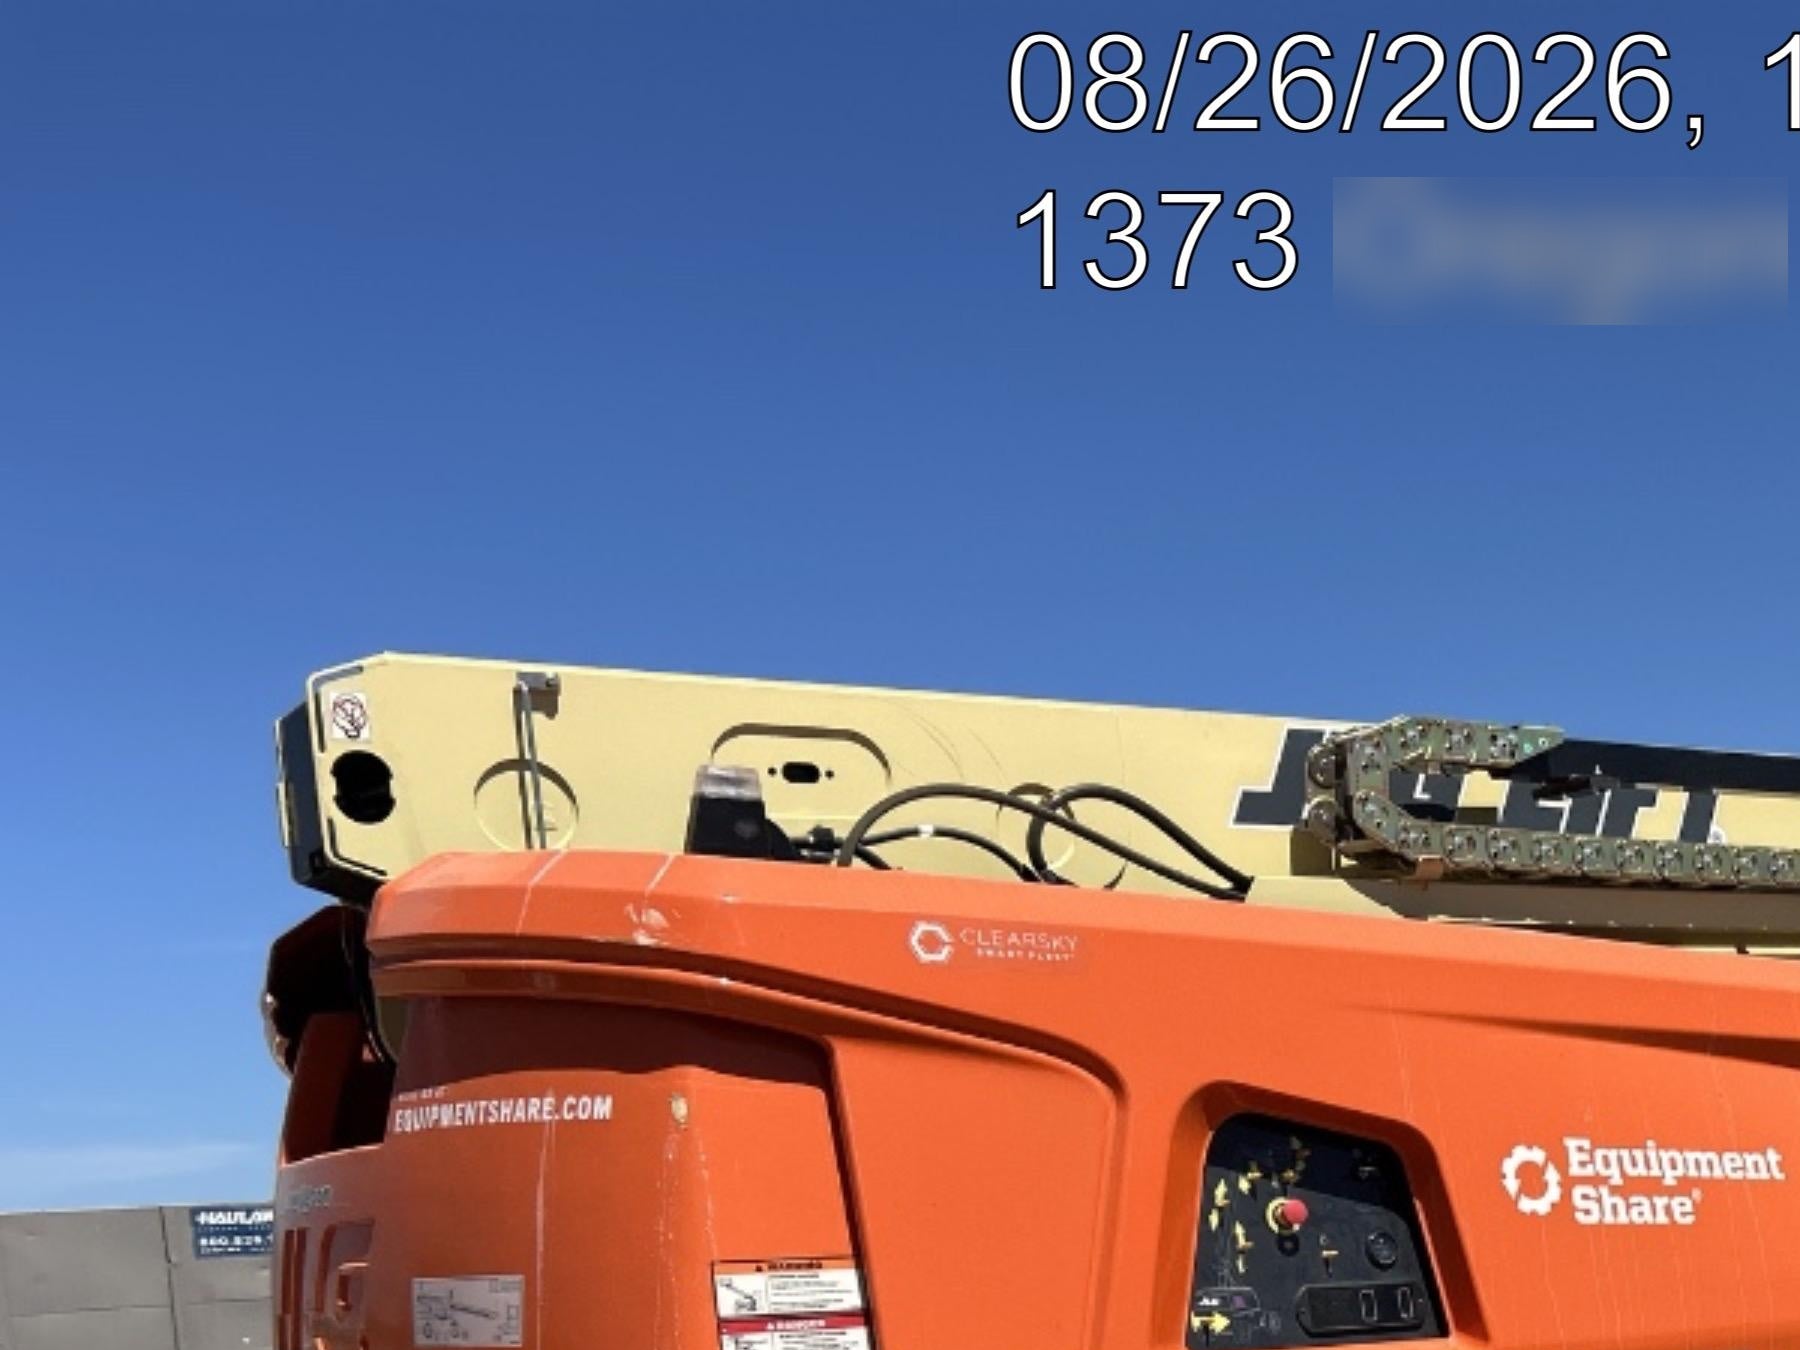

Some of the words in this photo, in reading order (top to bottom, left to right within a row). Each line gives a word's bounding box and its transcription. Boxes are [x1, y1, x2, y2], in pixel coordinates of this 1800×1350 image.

[959, 927, 1079, 952] CLEARSKY
[394, 1094, 613, 1134] EQUIPMENTSHARE.COM
[1563, 1136, 1786, 1187] Equipment
